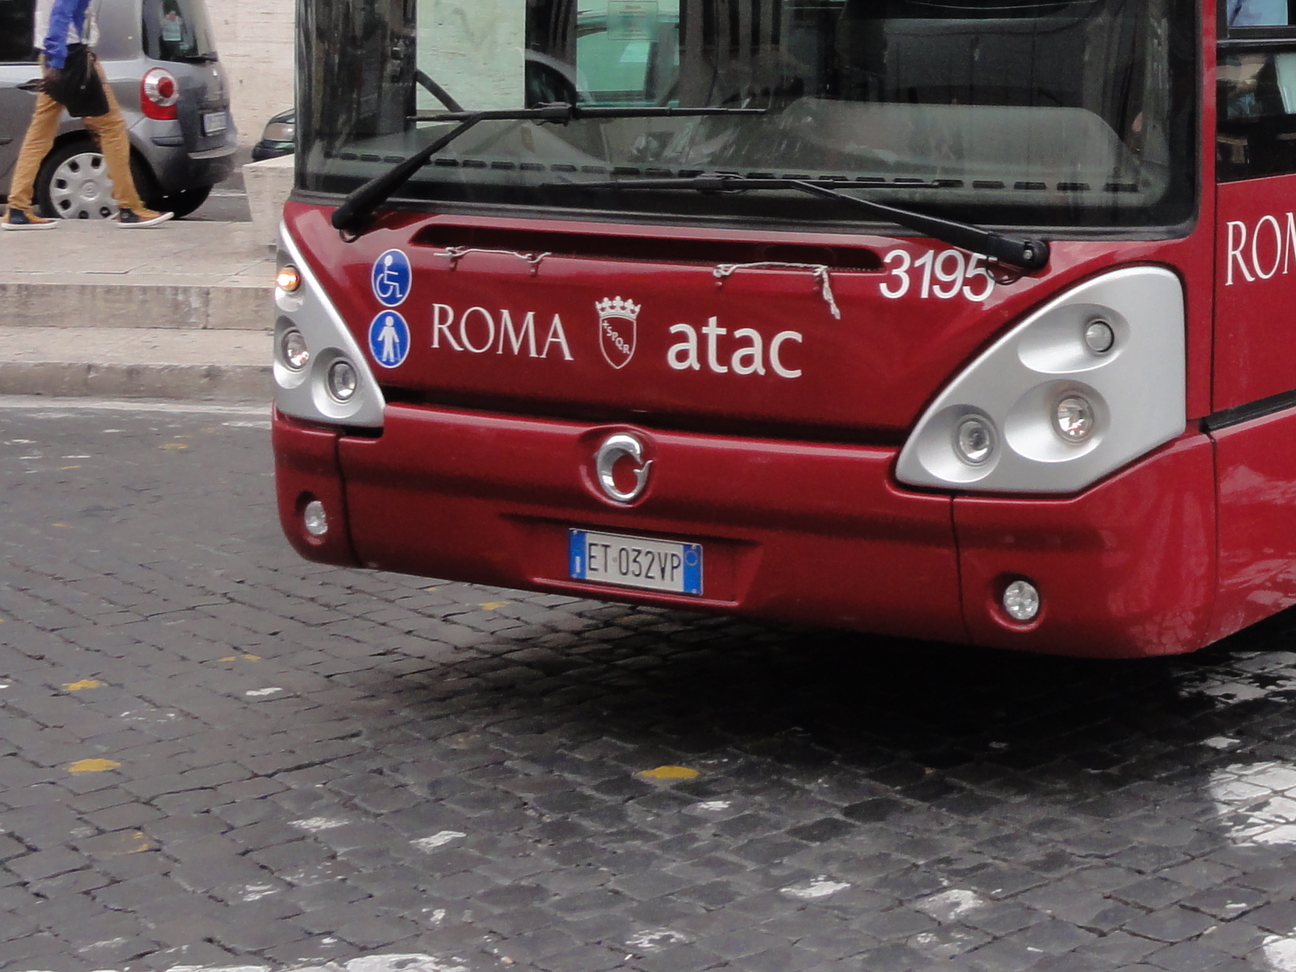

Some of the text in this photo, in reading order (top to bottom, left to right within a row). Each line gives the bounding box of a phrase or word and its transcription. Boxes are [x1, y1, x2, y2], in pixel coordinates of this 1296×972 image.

[879, 249, 998, 302] 3195
[431, 303, 574, 361] ROMA
[667, 316, 803, 379] atac
[618, 547, 681, 582] 032VP
